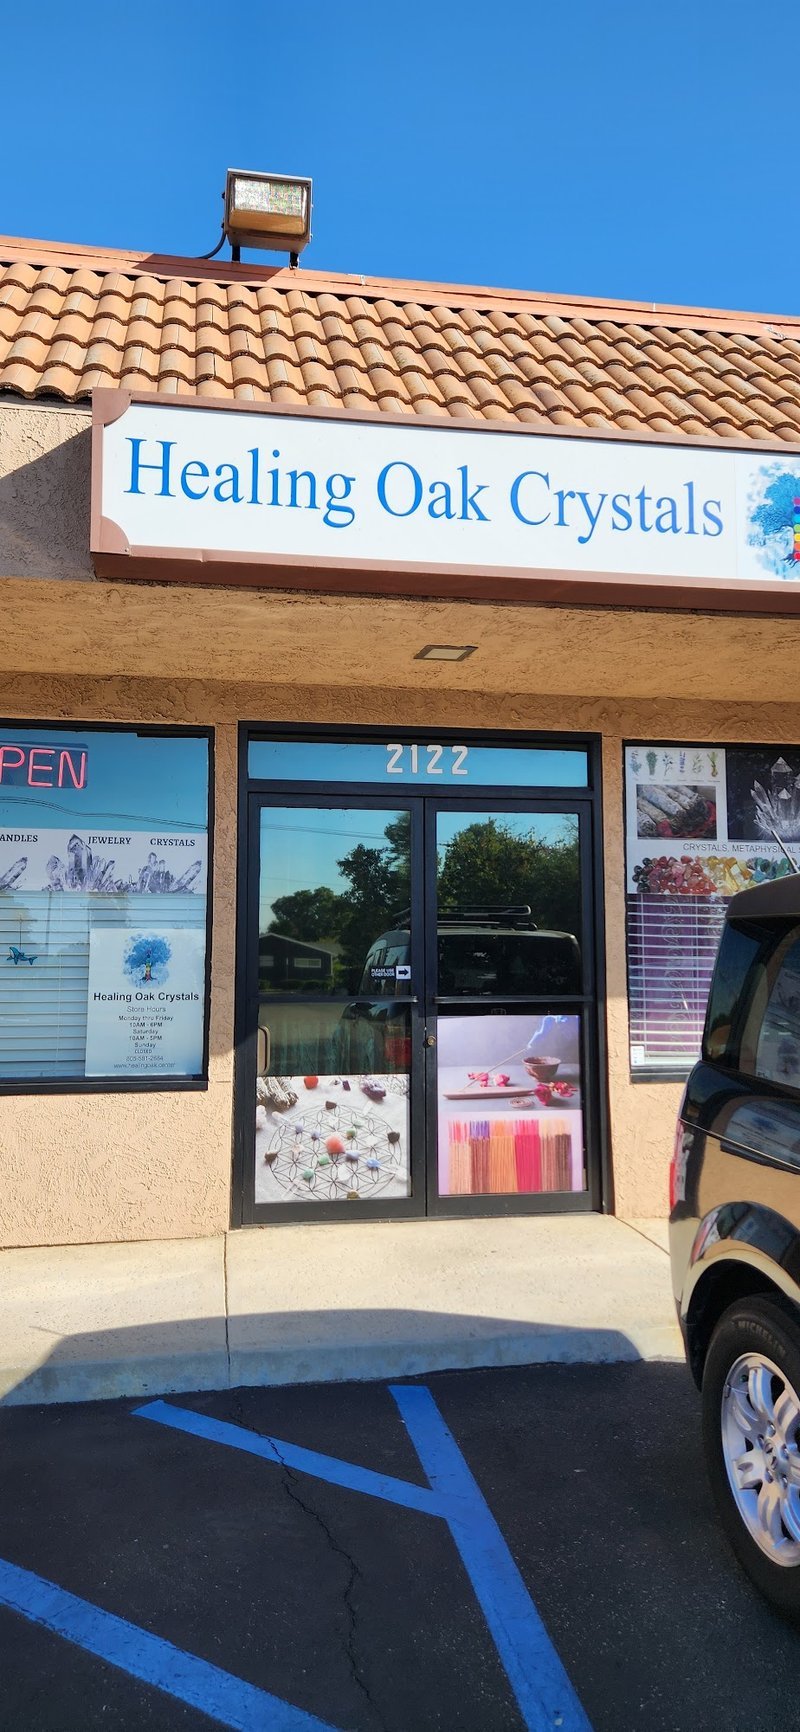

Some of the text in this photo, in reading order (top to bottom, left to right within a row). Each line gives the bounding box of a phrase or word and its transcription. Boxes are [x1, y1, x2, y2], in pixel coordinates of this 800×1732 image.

[124, 438, 723, 544] Healing Oak Crystals
[387, 744, 469, 774] 2122
[88, 836, 132, 845] JEWELRY
[150, 839, 195, 847] CRYSTALS
[683, 843, 730, 853] CRYSTALS,
[93, 992, 199, 1003] Healing Oak Crystals
